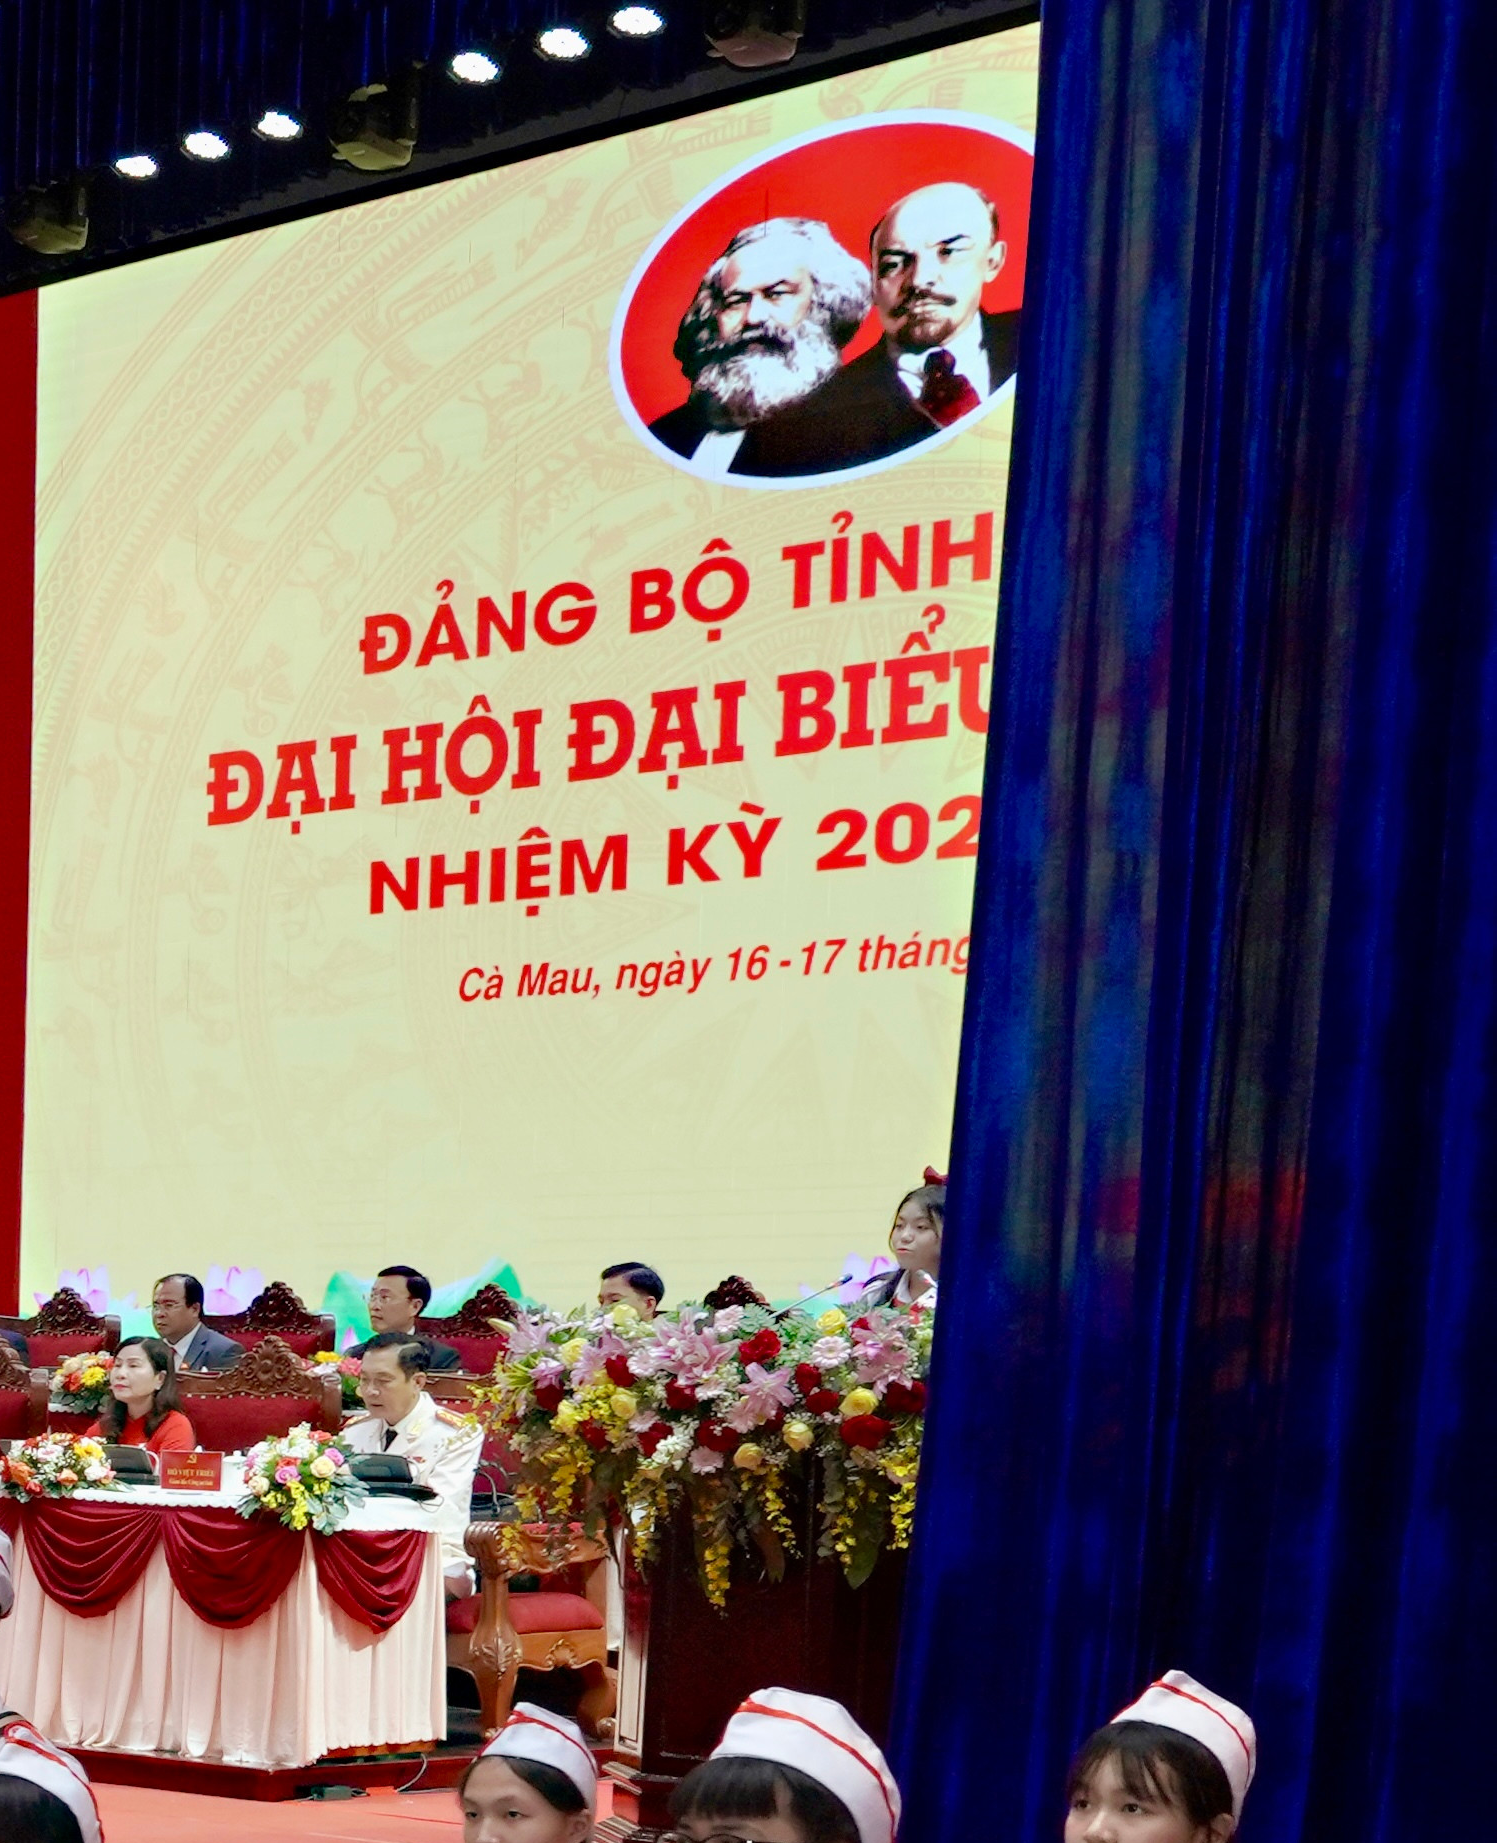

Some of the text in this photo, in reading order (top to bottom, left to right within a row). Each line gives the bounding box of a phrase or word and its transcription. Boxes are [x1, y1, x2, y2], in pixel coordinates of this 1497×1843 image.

[360, 511, 993, 674] ĐẢNG BỘ TỈNH
[206, 735, 357, 835] ĐẠI
[381, 695, 543, 815] HỘI
[567, 681, 746, 790] ĐẠI
[370, 796, 984, 917] NHIỆM KỲ 202
[458, 967, 504, 1002] Cà
[518, 962, 600, 997] Mau,
[615, 958, 713, 998] ngày
